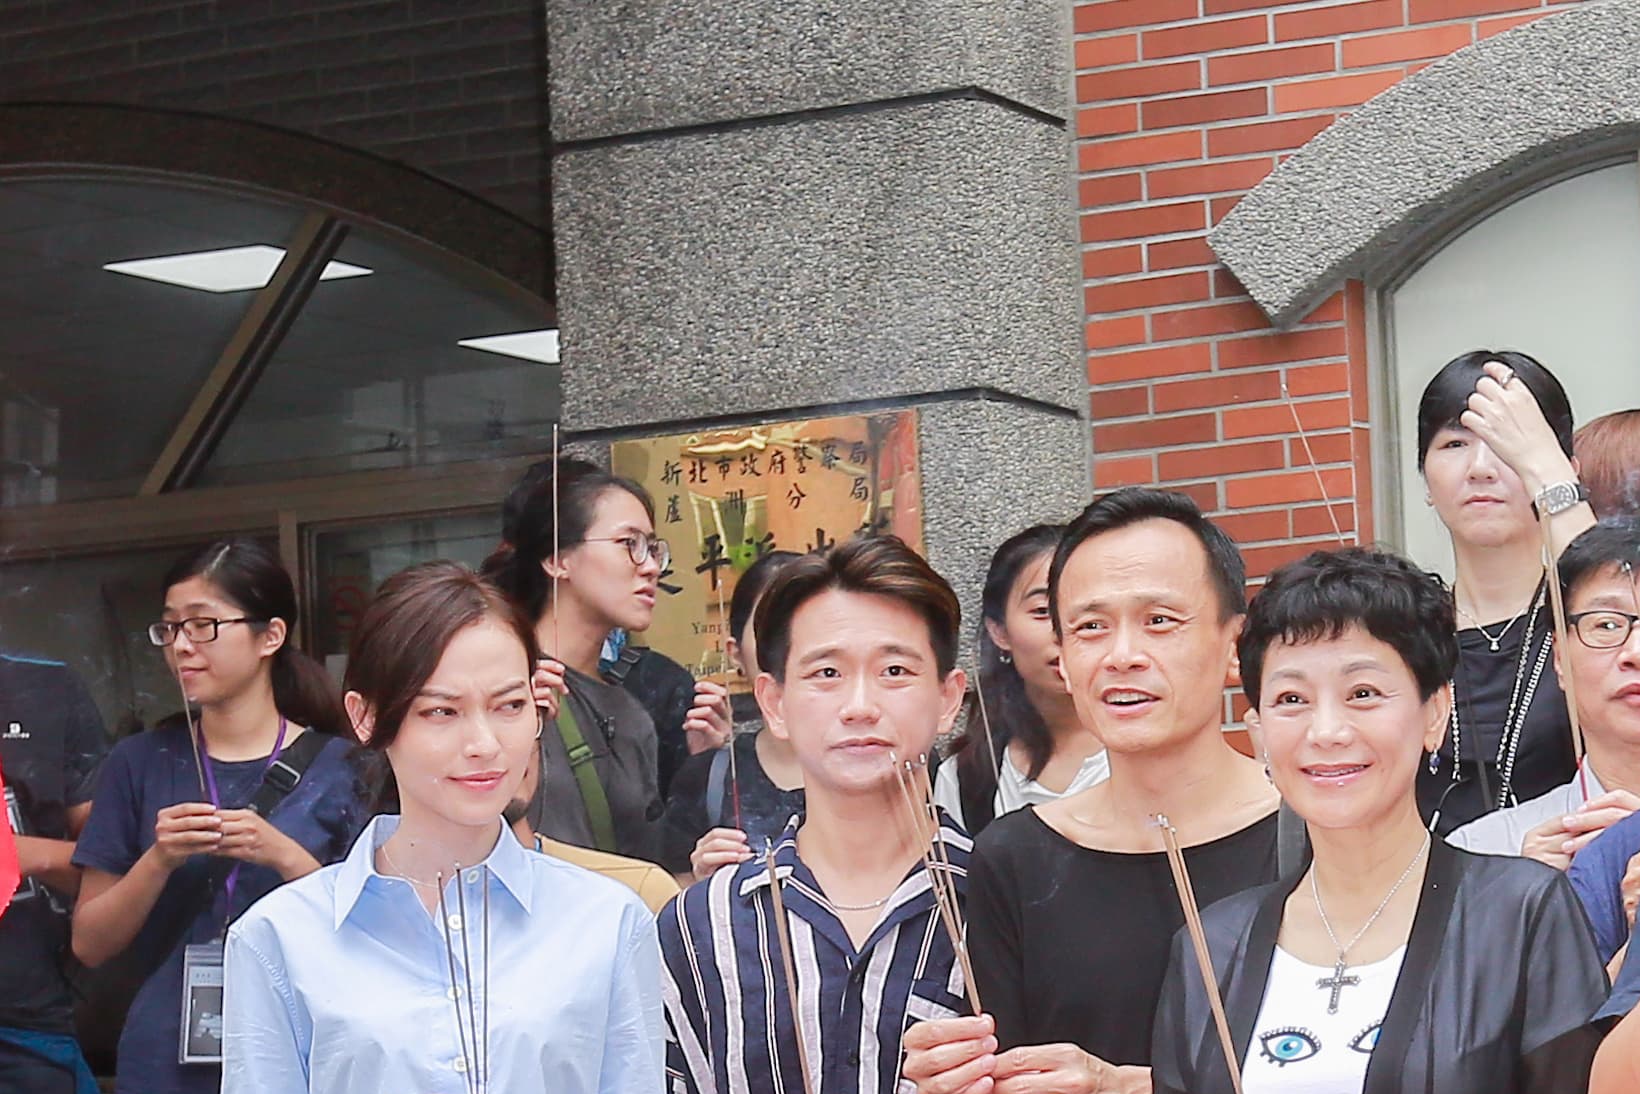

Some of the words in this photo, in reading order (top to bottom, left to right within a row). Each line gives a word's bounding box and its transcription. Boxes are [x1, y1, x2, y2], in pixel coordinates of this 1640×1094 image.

[661, 439, 870, 486] 新北市政府警察局
